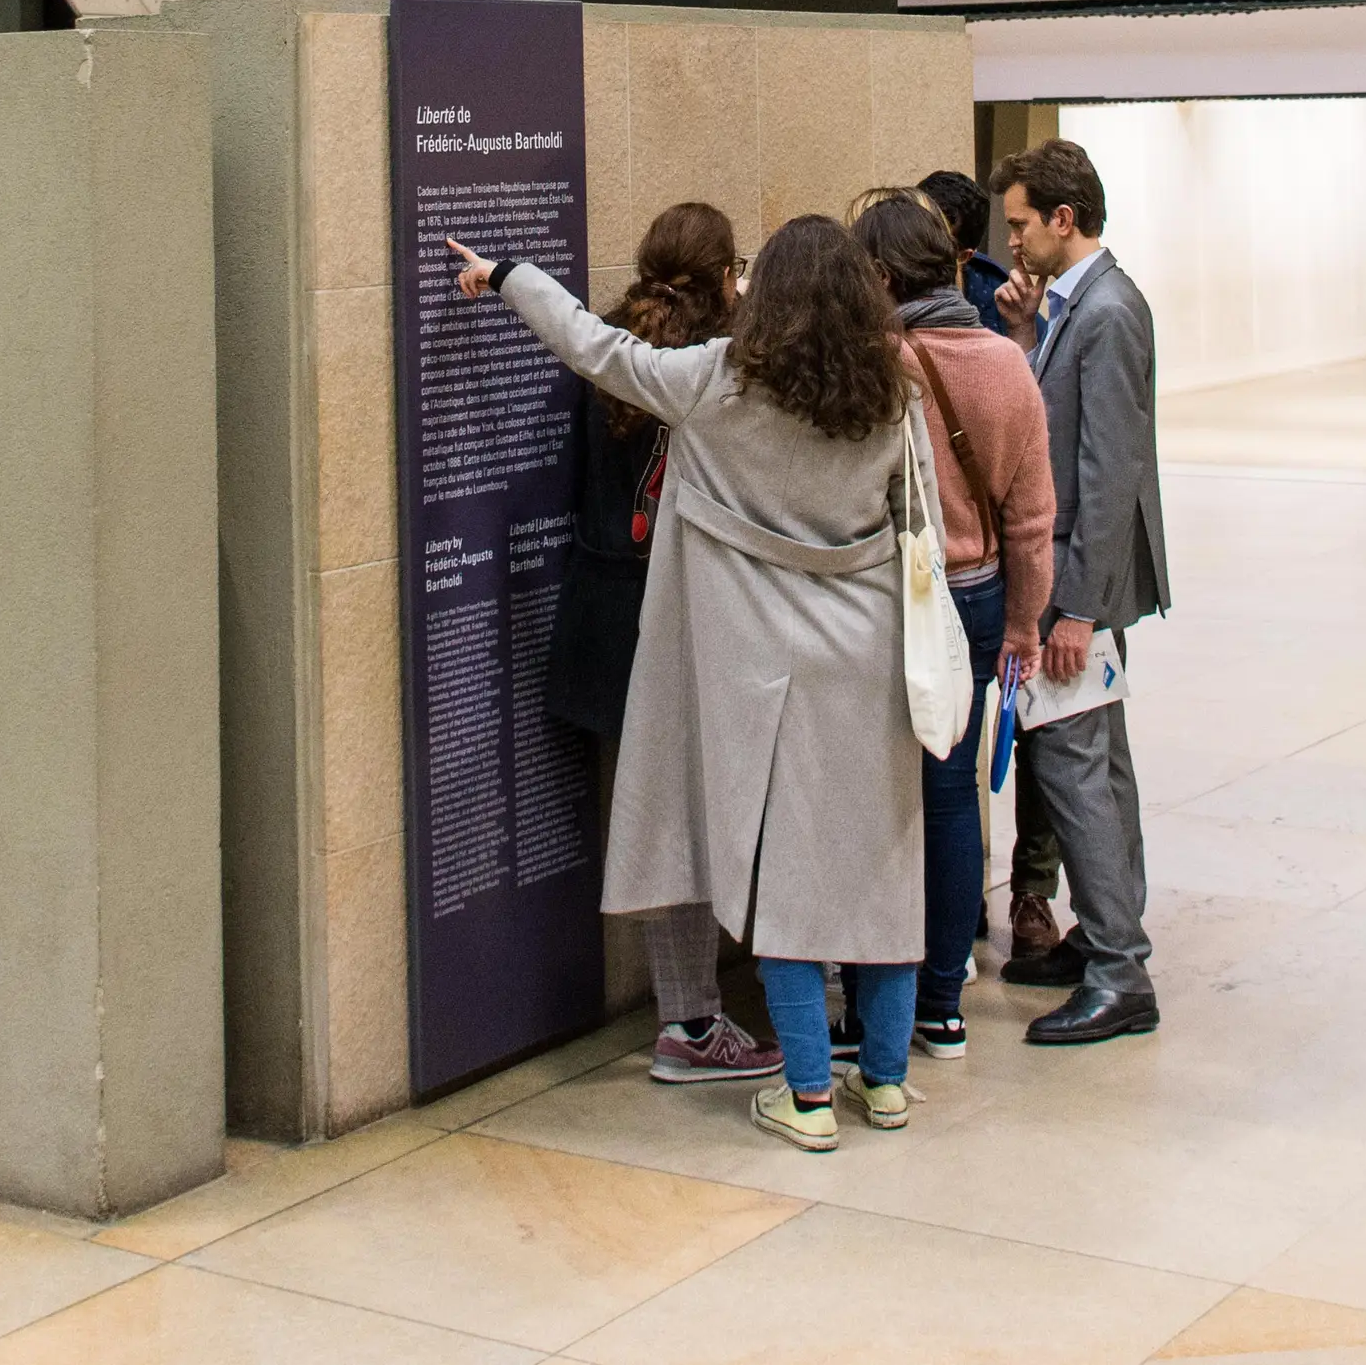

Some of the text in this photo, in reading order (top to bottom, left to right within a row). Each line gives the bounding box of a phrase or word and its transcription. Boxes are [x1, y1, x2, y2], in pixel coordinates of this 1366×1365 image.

[416, 106, 471, 124] Liberté de
[417, 131, 563, 155] Frédéric-Auguste Bartholdi
[417, 180, 569, 196] Cadeau de la jeune Troisième République française pour
[417, 202, 423, 211] le
[424, 200, 451, 211] centième
[451, 198, 487, 209] anniversaire
[487, 198, 495, 207] de
[496, 195, 537, 208] l'Indépendance
[538, 195, 548, 204] des
[417, 218, 425, 226] en
[443, 215, 449, 225] la
[450, 214, 469, 224] statue
[469, 213, 477, 223] de
[478, 213, 484, 222] la
[484, 212, 503, 222] Liberté
[504, 211, 511, 221] de
[512, 209, 558, 222] Frédéric-Auguste
[418, 231, 445, 242] Bartholdi
[456, 228, 480, 239] devenue
[481, 229, 492, 237] une
[492, 227, 502, 237] des
[503, 226, 522, 238] figures
[523, 224, 549, 236] iconiques
[522, 340, 545, 353] europée
[509, 519, 535, 536] Liberté
[425, 536, 463, 554] Liberty by
[509, 532, 572, 554] Frédéric-Auguste
[425, 549, 494, 573] Frédéric-Auguste
[510, 554, 545, 574] Bartholdi
[426, 572, 463, 592] Bartholdi
